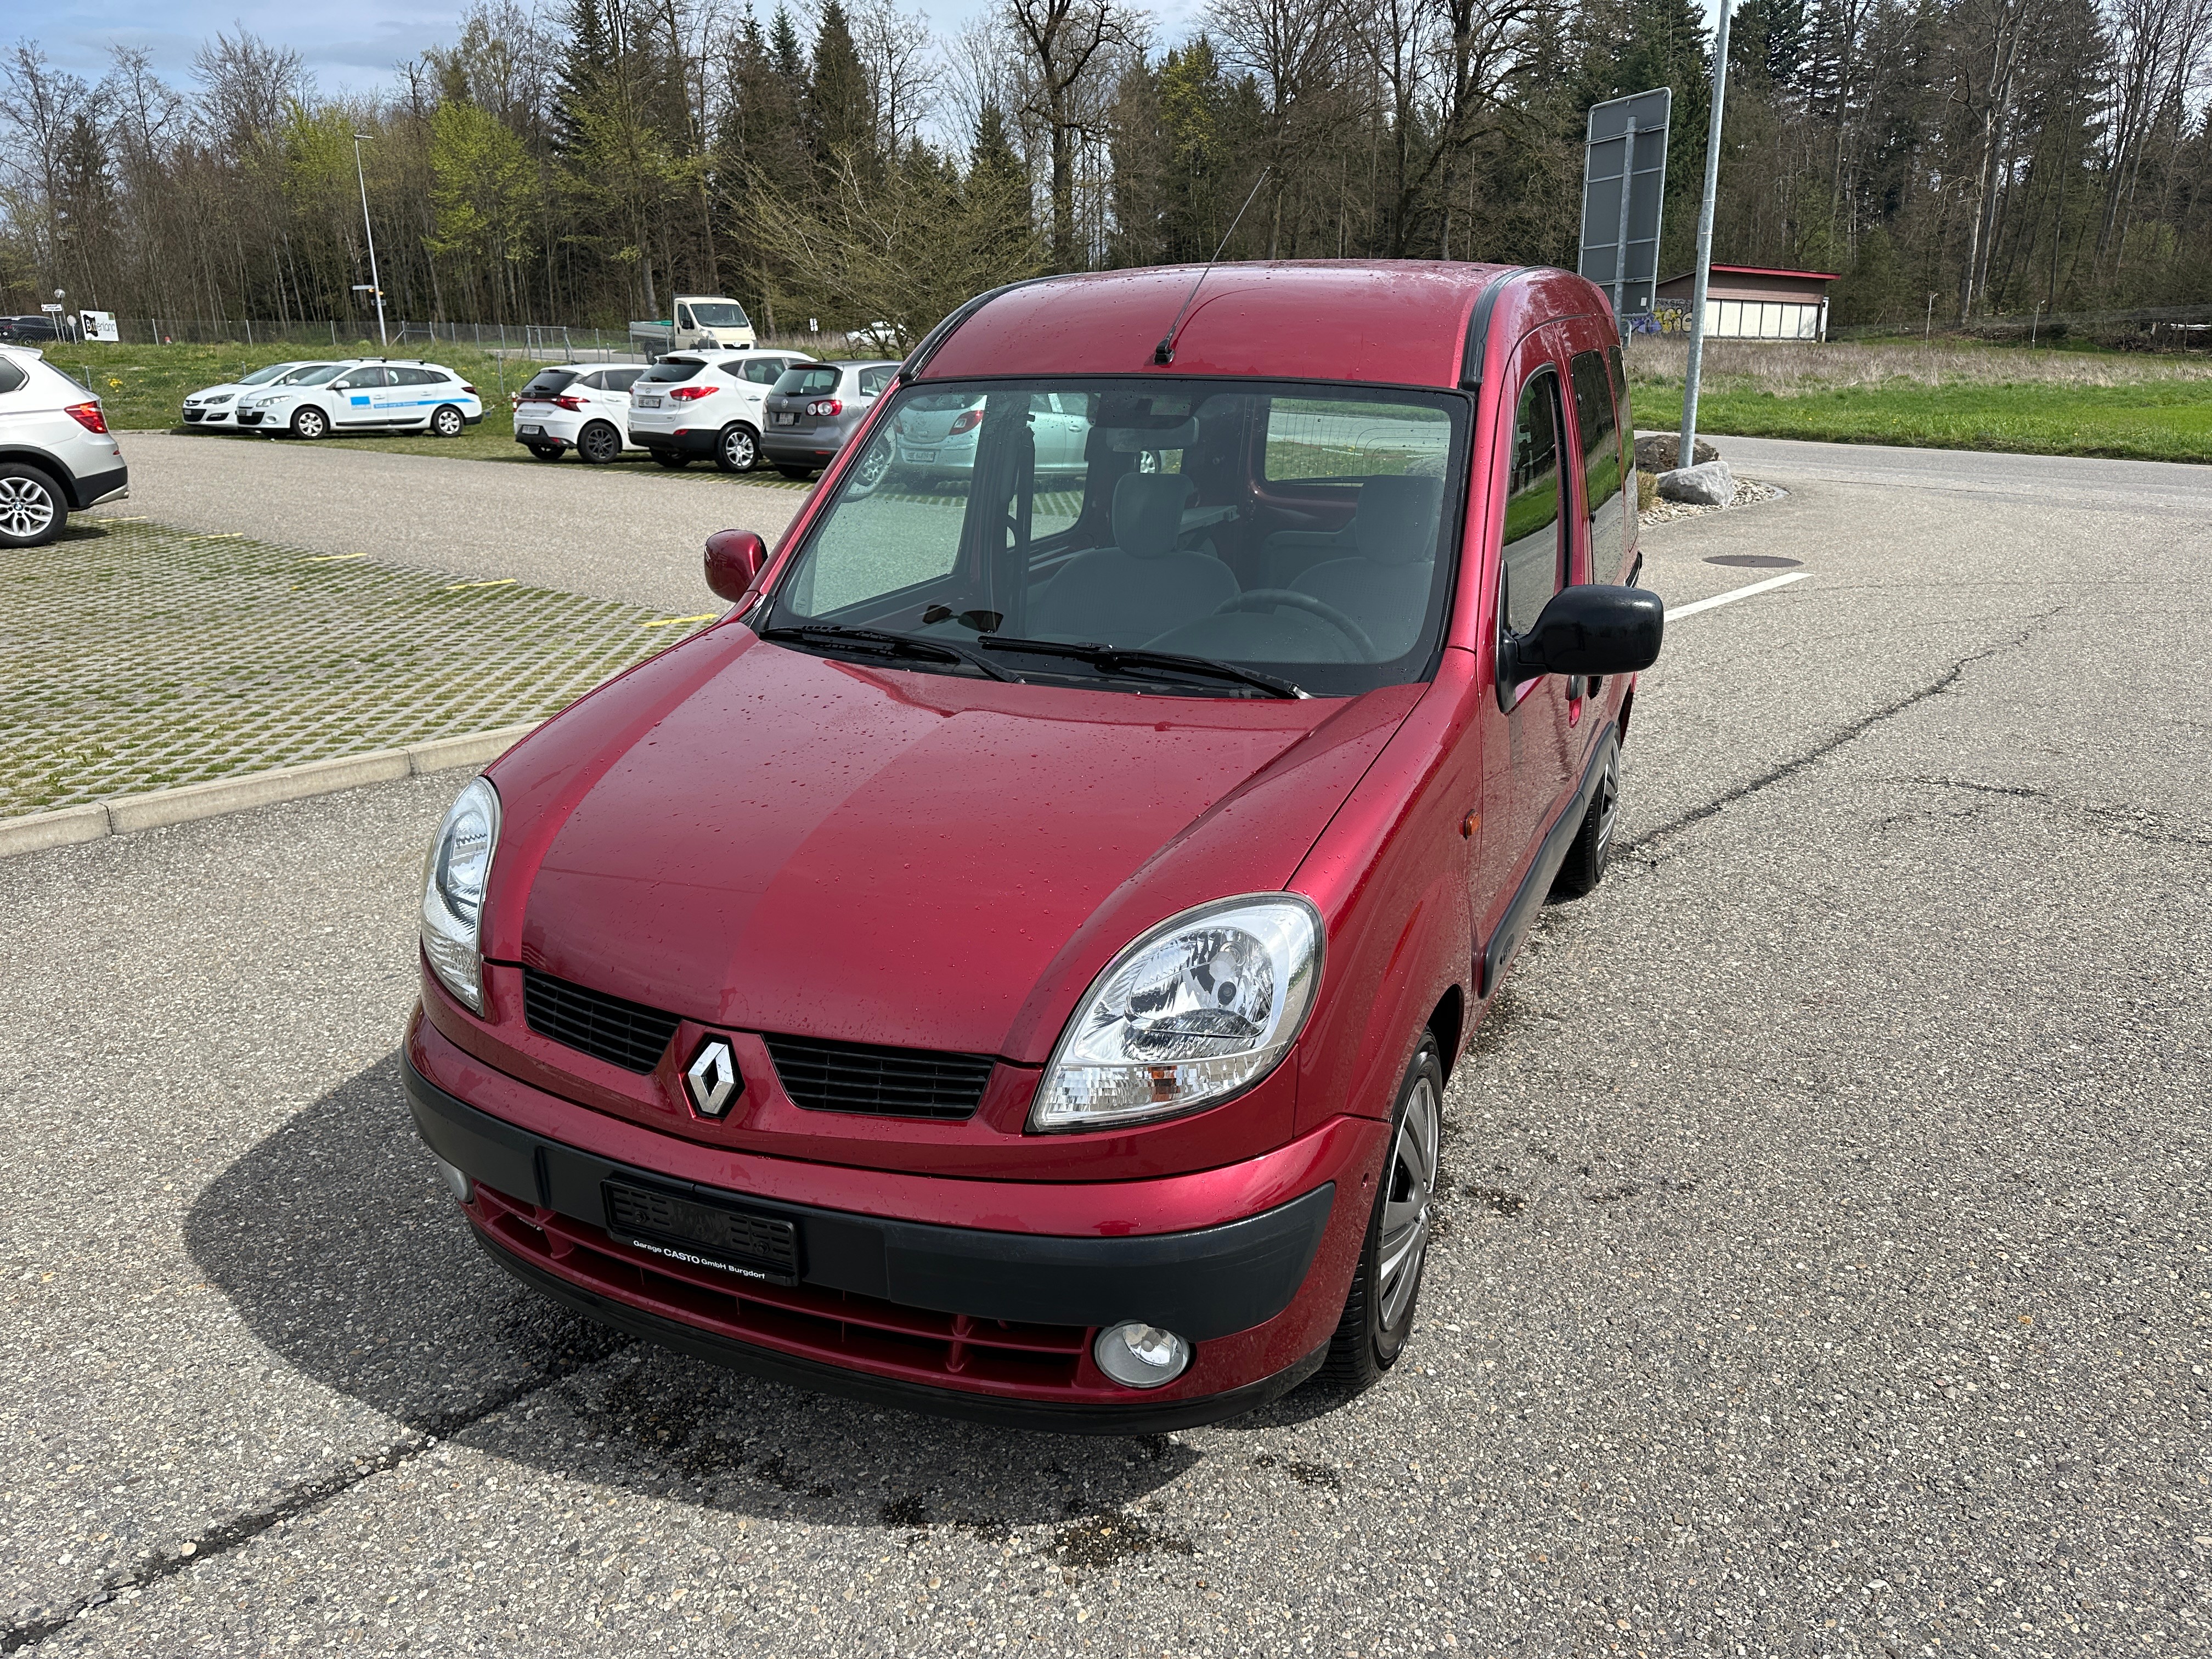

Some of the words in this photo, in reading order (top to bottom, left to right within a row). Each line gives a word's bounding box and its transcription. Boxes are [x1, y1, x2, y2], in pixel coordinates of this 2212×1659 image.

[633, 1240, 662, 1253] Garage
[663, 1248, 700, 1264] CASTO
[701, 1259, 726, 1270] GmbH
[728, 1265, 765, 1279] Burgdorf
